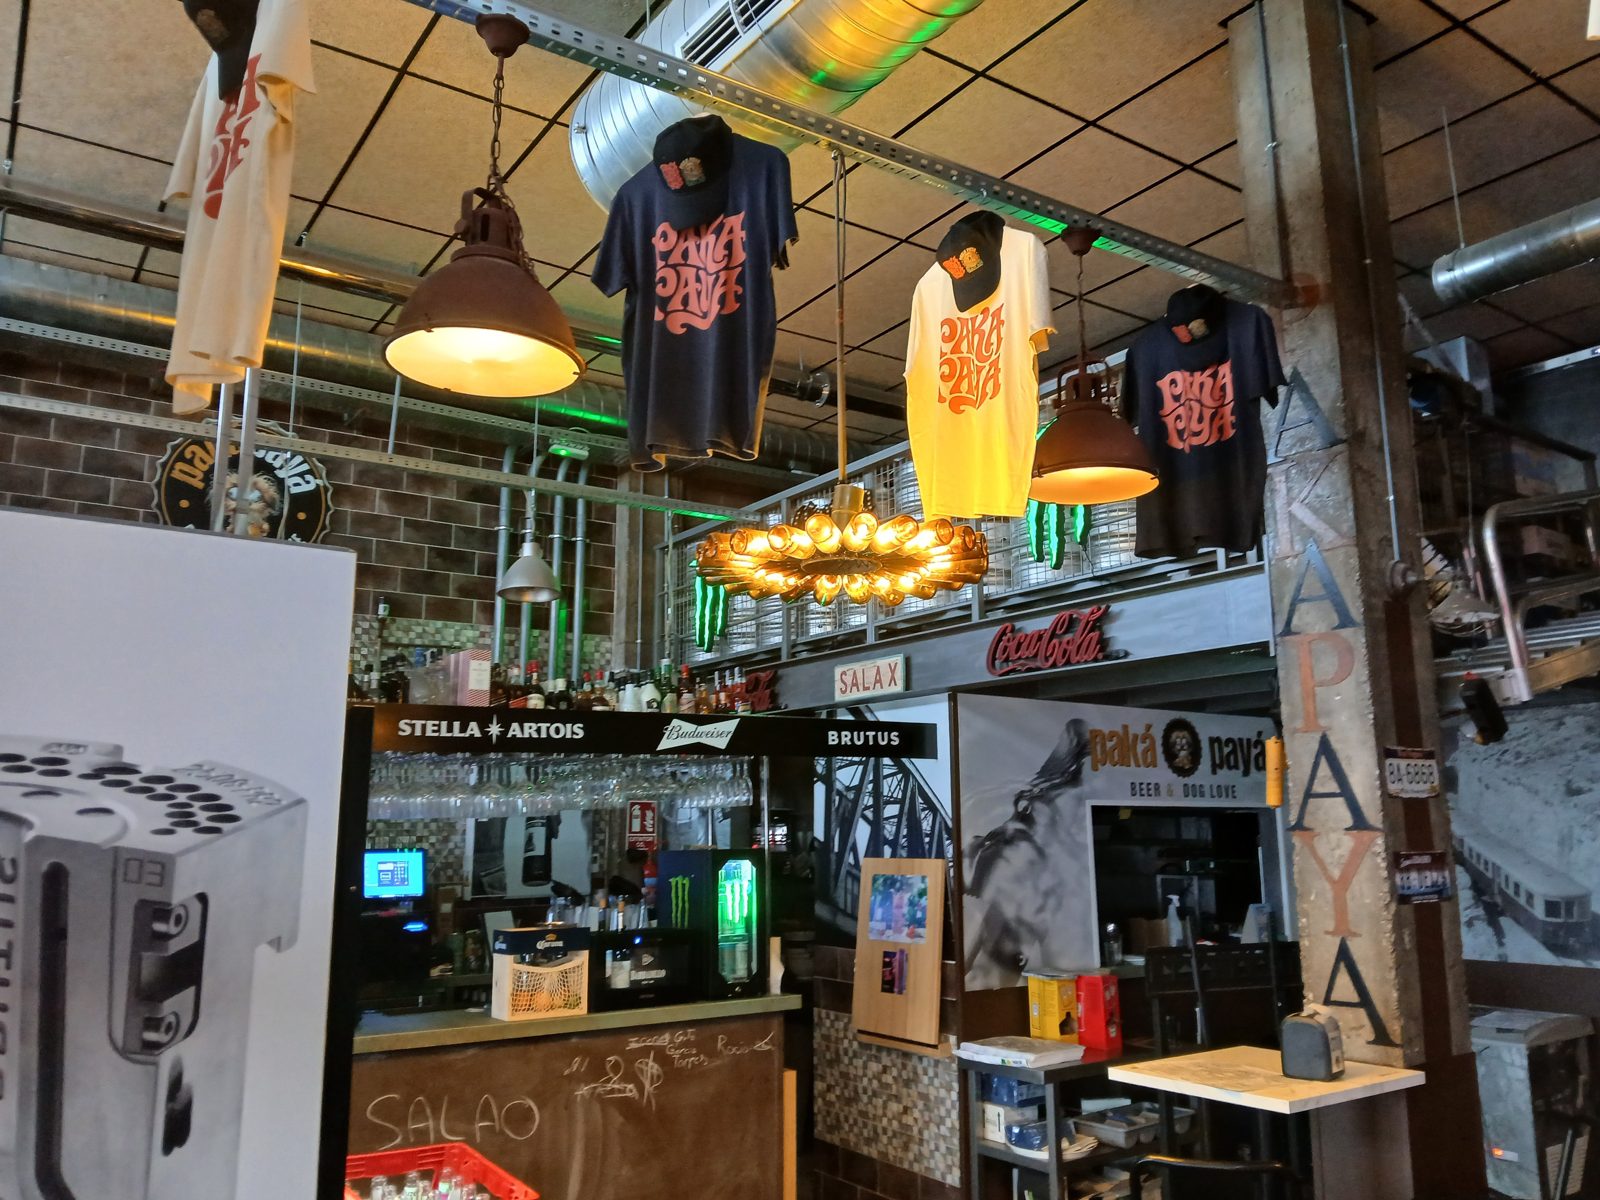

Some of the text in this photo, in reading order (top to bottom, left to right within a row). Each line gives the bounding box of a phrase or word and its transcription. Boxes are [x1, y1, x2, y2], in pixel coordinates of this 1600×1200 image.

[398, 719, 585, 739] STELLA ARTOIS
[663, 724, 734, 741] Budweiser
[828, 731, 900, 746] BRUTUS
[1089, 723, 1158, 771] paká
[1130, 781, 1161, 797] BEER
[1182, 783, 1205, 798] DOG
[1210, 784, 1238, 799] LOVE
[1284, 631, 1403, 1048] PAYA
[366, 1094, 541, 1151] SALAO
